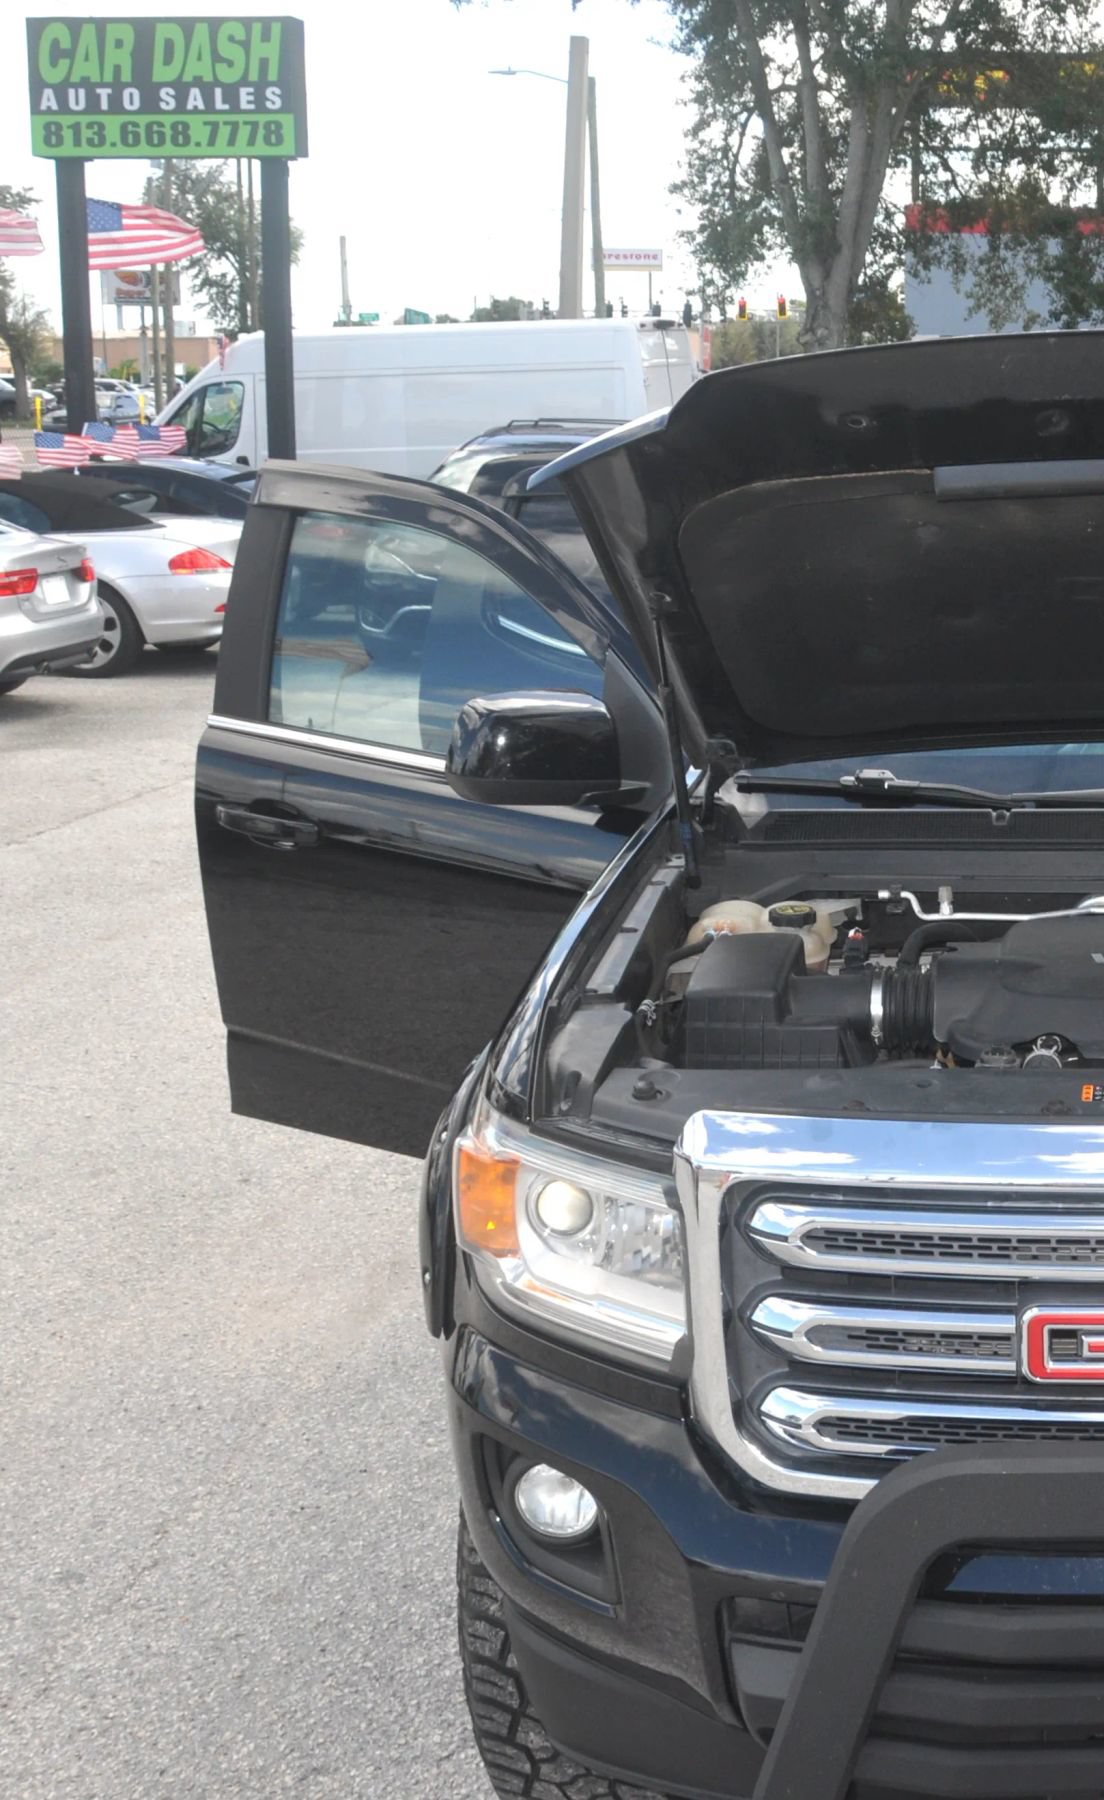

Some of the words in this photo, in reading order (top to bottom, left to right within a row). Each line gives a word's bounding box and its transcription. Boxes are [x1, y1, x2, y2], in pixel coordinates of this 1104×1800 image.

[38, 22, 135, 84] CAR
[152, 21, 281, 84] DASH
[40, 87, 141, 111] AUTO
[159, 86, 282, 110] SALES
[42, 120, 284, 148] 813.668.7778
